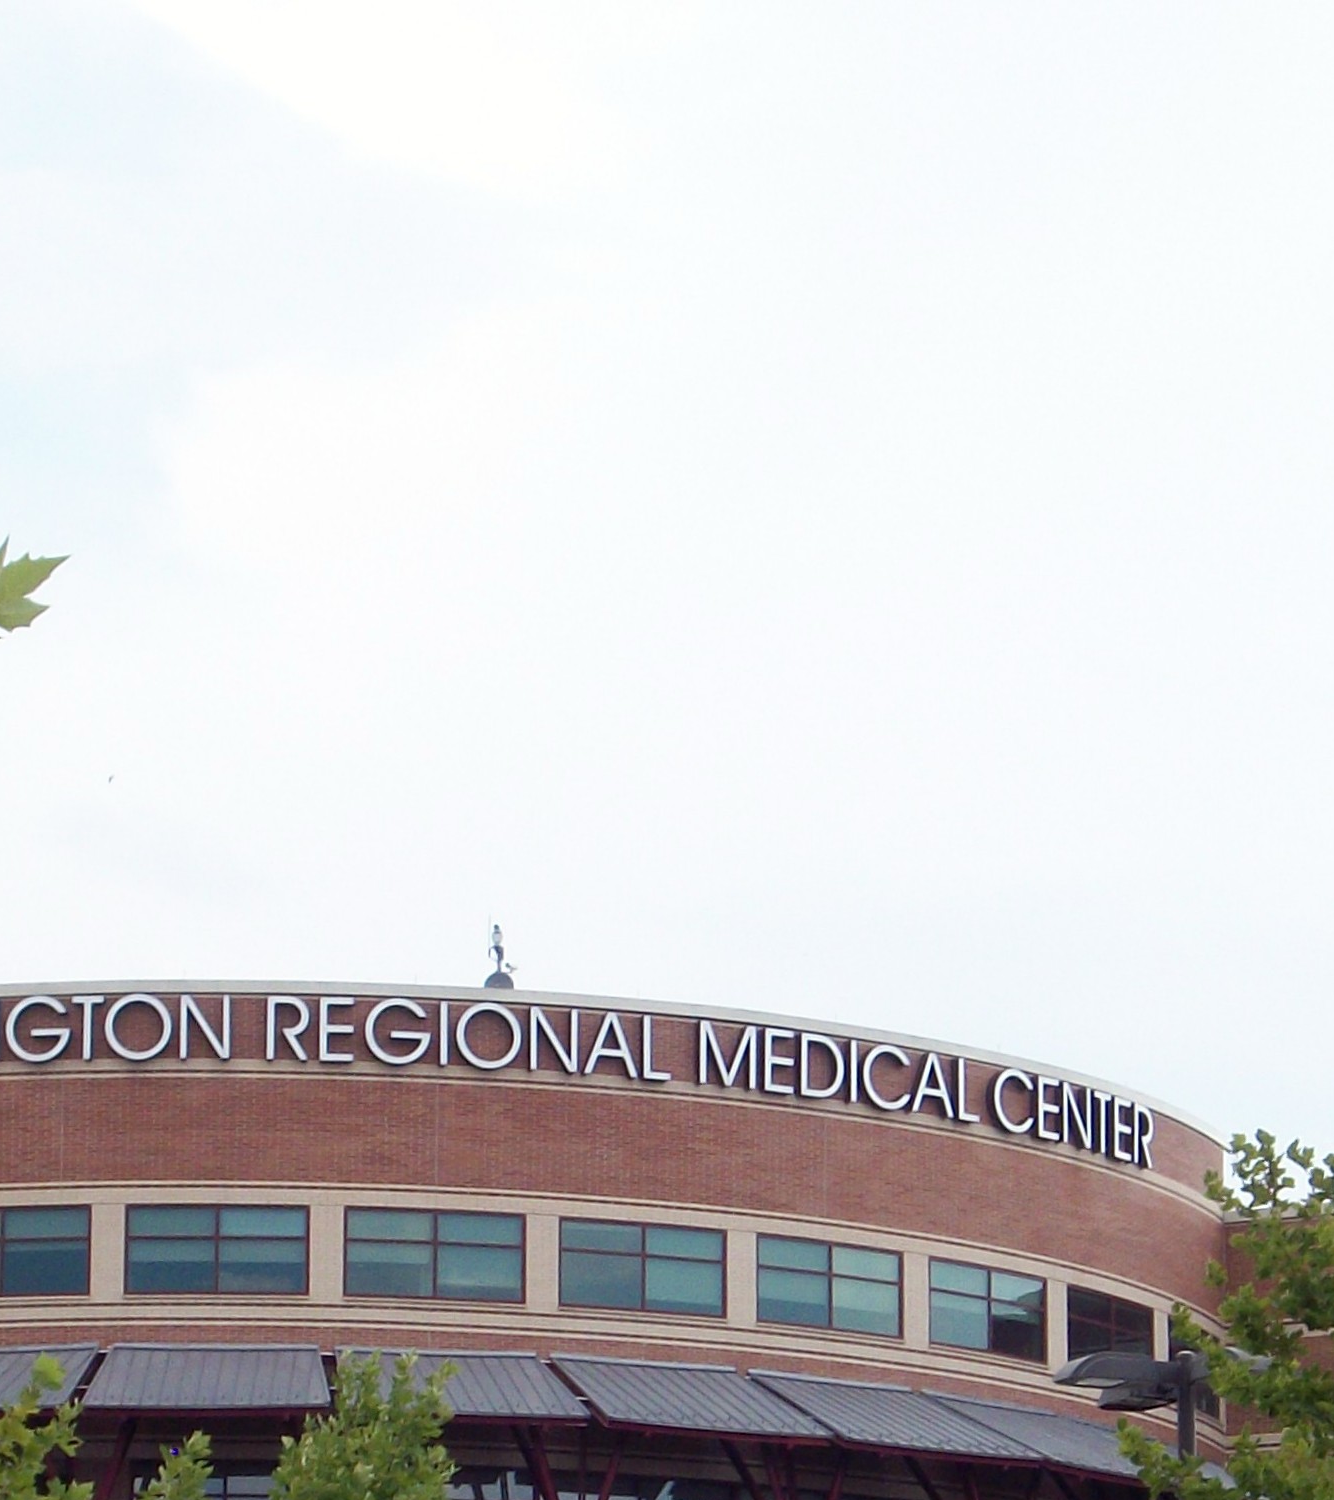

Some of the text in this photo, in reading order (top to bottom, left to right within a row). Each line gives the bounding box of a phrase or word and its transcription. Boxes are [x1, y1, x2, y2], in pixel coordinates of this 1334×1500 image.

[265, 994, 672, 1082] REGIONAL
[697, 1019, 981, 1124] MEDICAL
[993, 1068, 1156, 1170] CENTER
